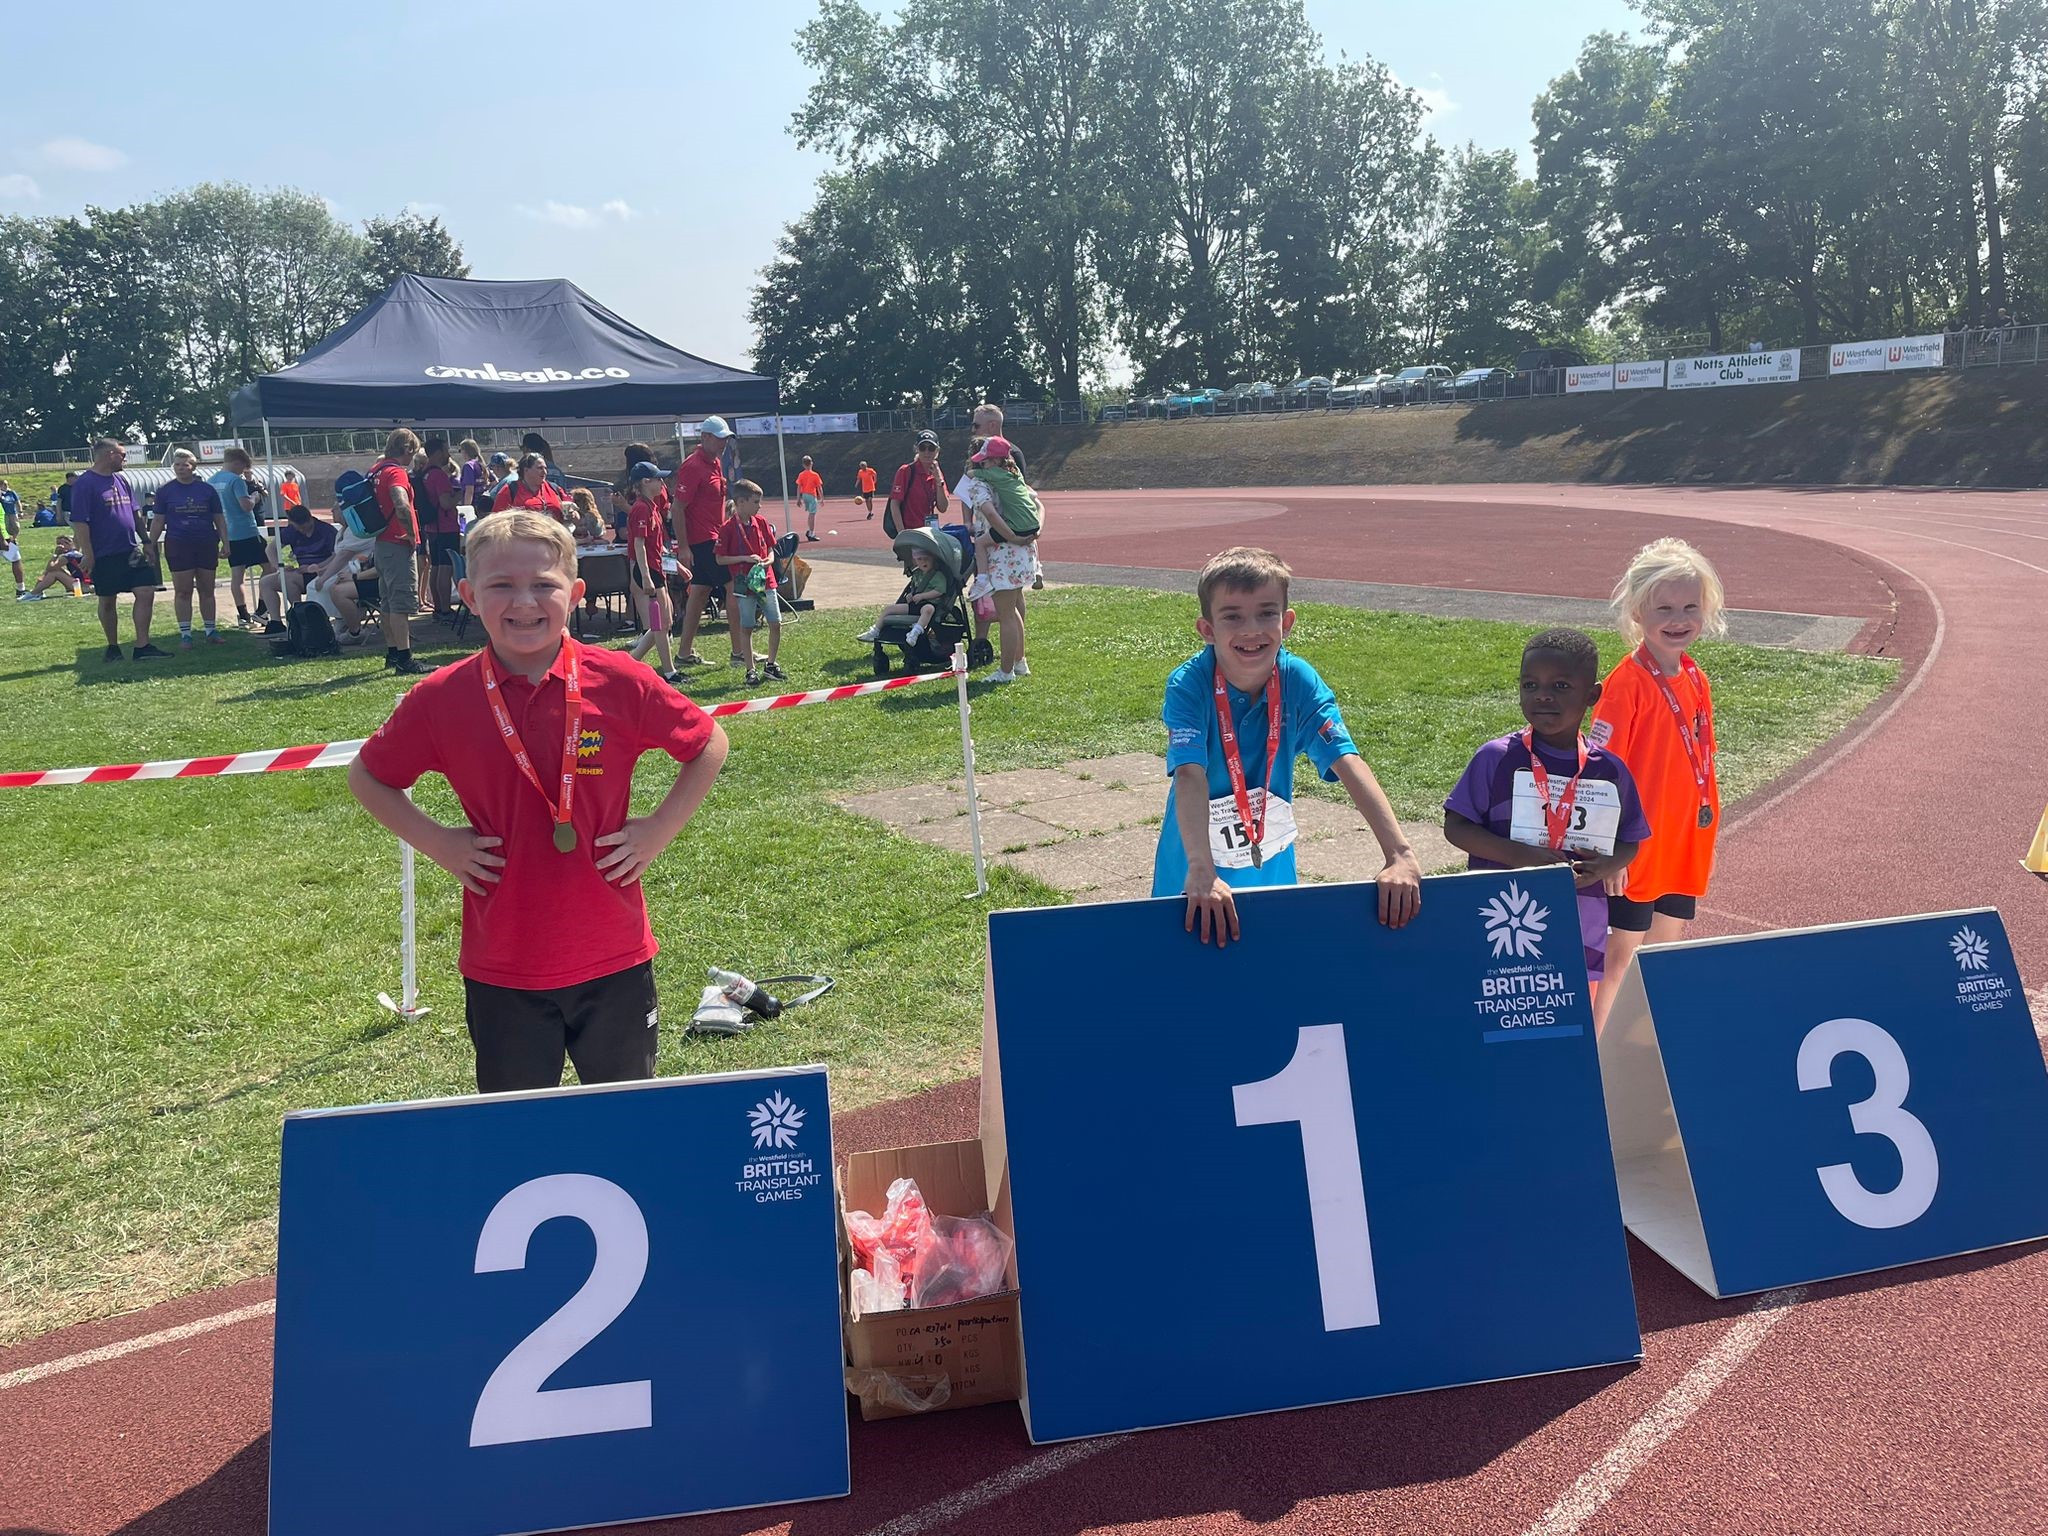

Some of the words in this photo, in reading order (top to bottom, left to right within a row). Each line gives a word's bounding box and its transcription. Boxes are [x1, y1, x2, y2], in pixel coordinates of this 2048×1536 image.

[1846, 348, 1882, 358] Westfield
[1903, 342, 1940, 353] Westfield
[1694, 359, 1723, 370] Notts
[1728, 354, 1772, 368] Athletic
[1580, 370, 1611, 379] Westfield
[1630, 367, 1661, 375] Westfield
[1720, 369, 1744, 380] Club
[1499, 965, 1532, 974] Westfield
[1533, 963, 1555, 971] Health
[1482, 972, 1564, 997] BRITISH
[1957, 977, 2005, 994] BRITISH
[1474, 992, 1576, 1014] TRANSPLANT
[1955, 988, 2012, 1005] TRANSPLANT
[1971, 1000, 2003, 1012] GAMES
[1500, 1011, 1555, 1029] GAMES
[1797, 1019, 1938, 1228] 3
[759, 1153, 788, 1162] Westfield
[743, 1159, 813, 1178] BRITISH
[735, 1174, 821, 1192] TRANSPLANT
[1232, 1024, 1380, 1331] 1
[755, 1188, 803, 1203] GAMES
[470, 1174, 651, 1447] 2
[961, 1333, 979, 1344] PCS
[963, 1349, 980, 1359] KGS
